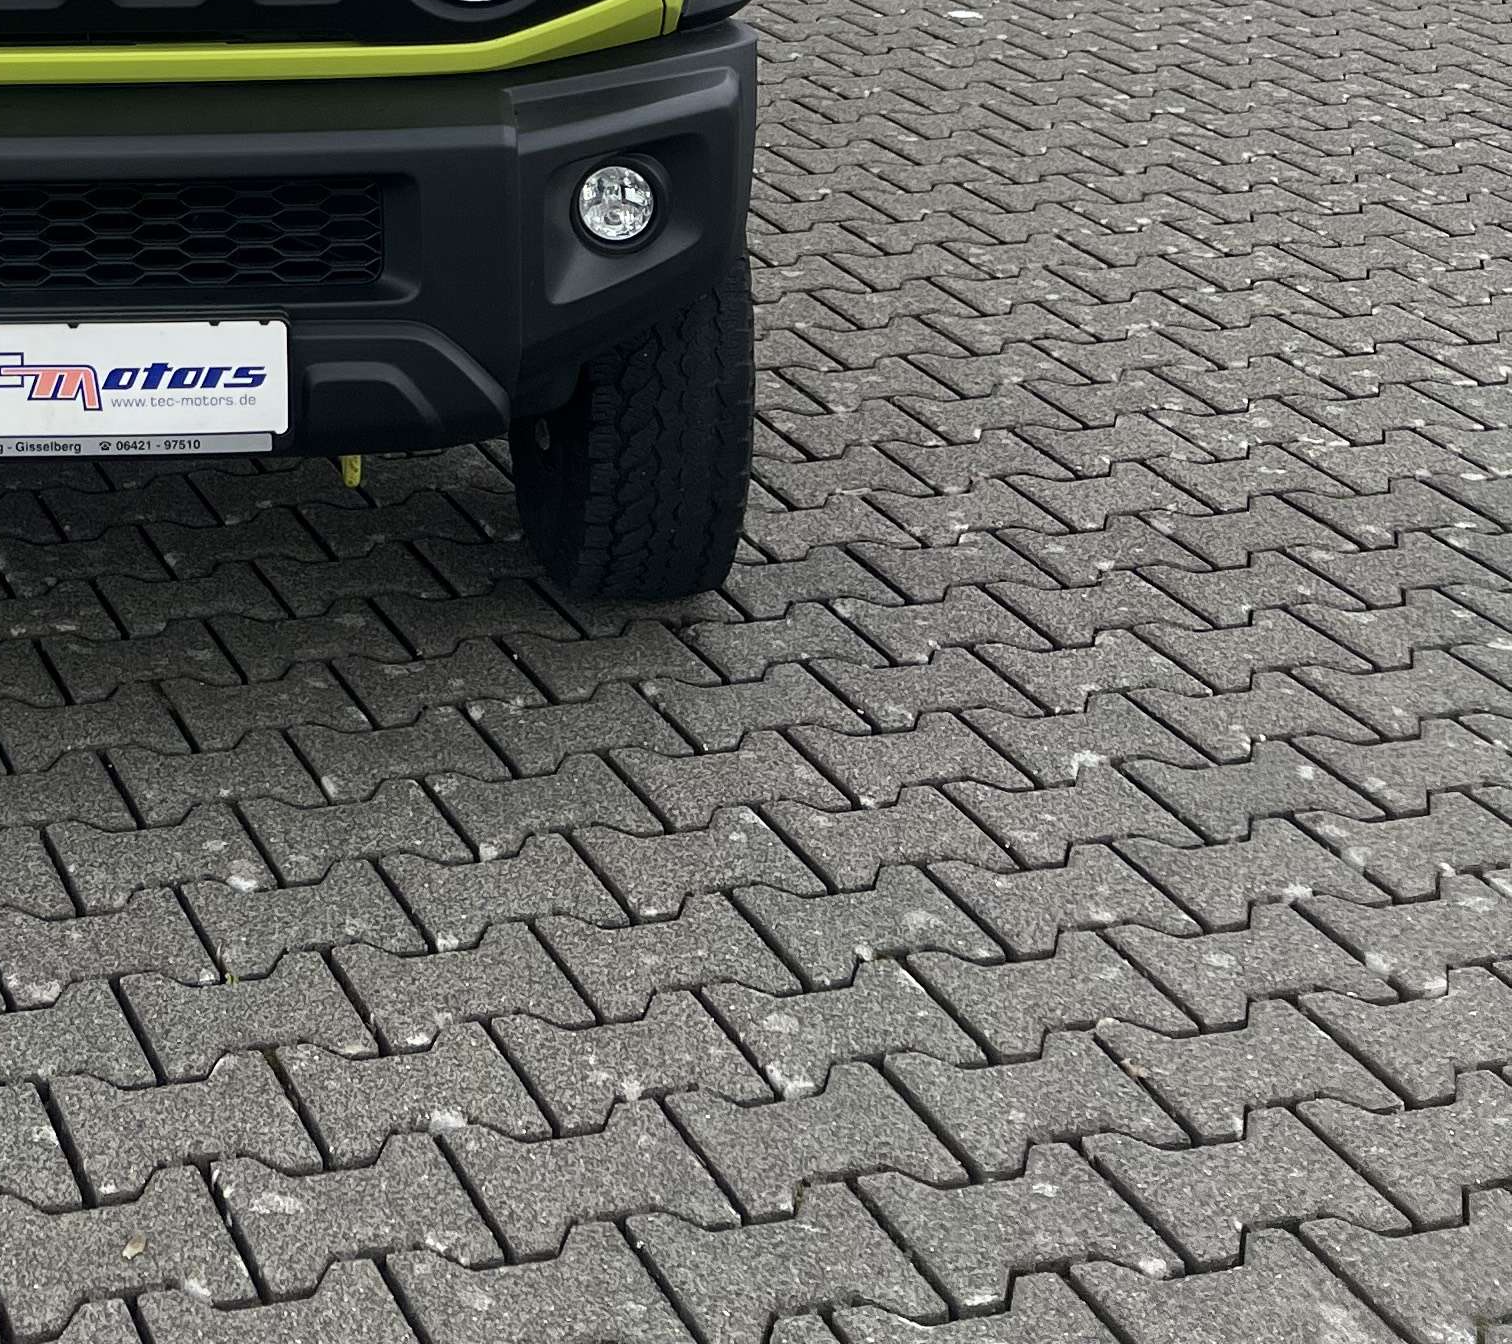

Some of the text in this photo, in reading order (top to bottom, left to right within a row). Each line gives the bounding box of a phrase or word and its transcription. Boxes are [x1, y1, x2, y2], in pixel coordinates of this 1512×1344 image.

[111, 393, 257, 408] www.tec-motors.de
[15, 441, 82, 453] Gisselberg
[116, 440, 152, 451] 06421
[164, 439, 201, 450] 97510
